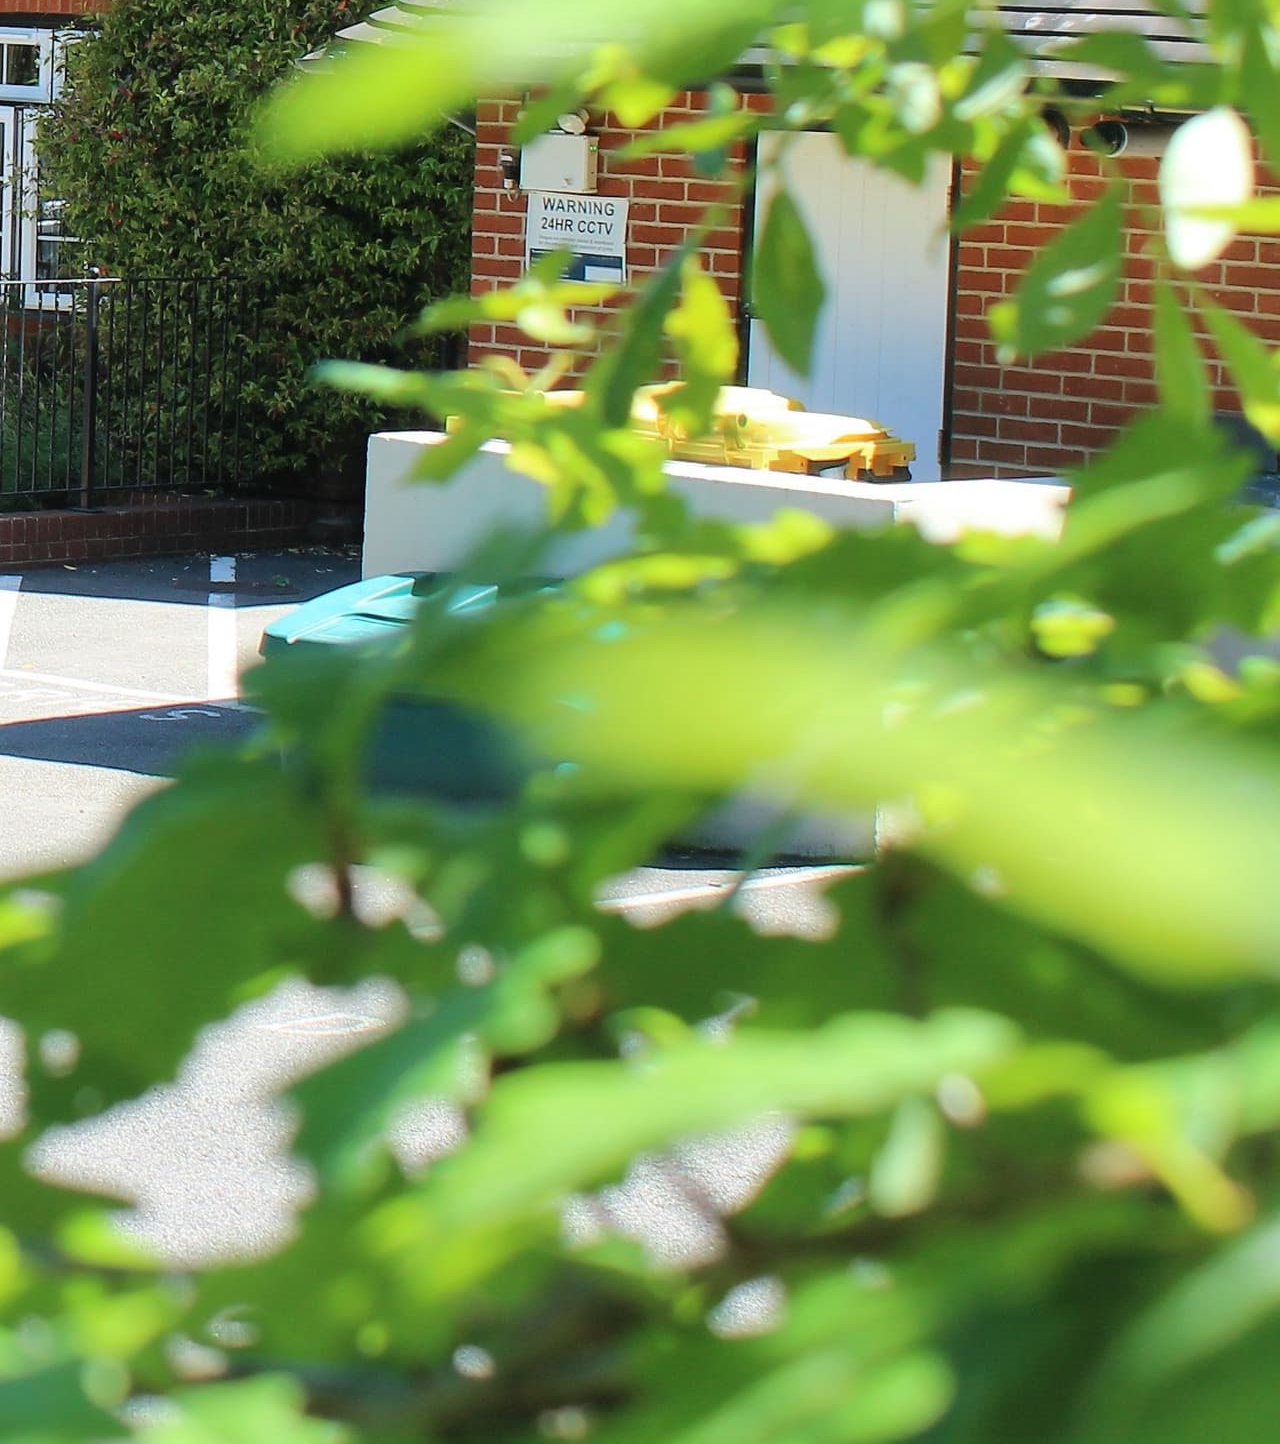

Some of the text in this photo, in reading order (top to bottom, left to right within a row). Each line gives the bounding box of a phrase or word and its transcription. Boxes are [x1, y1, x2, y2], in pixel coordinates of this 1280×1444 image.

[542, 197, 615, 217] WARNING
[541, 217, 613, 235] 24HR CCTV
